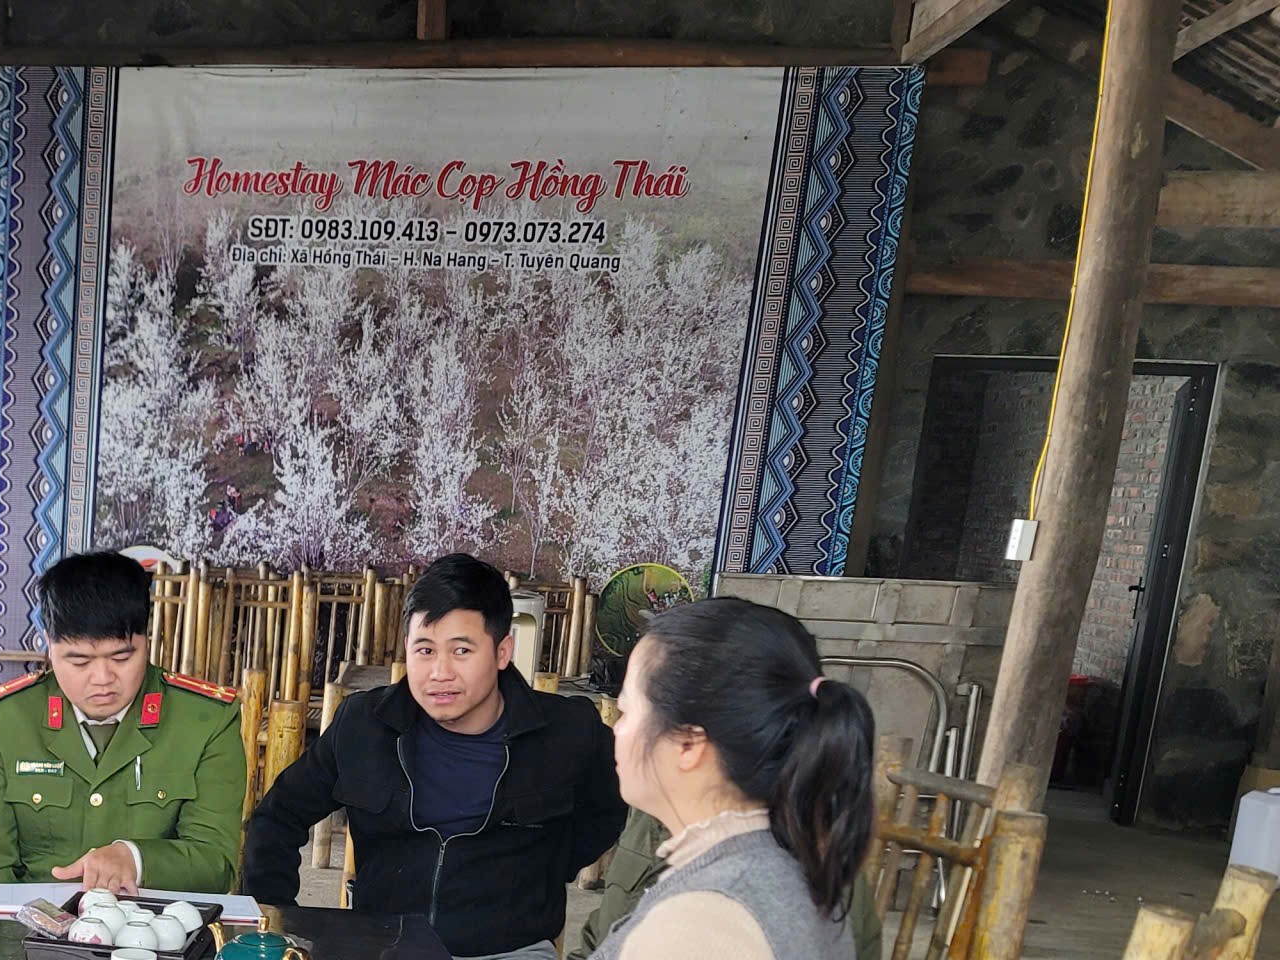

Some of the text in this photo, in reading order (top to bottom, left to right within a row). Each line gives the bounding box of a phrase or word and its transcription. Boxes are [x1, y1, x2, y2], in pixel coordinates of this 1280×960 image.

[184, 156, 689, 213] Homestay Mác Cọp Hồng Thái
[249, 218, 294, 239] SĐT:
[301, 219, 439, 241] 0983.109.413
[464, 221, 605, 243] 0973.073.274
[231, 246, 255, 265] Địa
[290, 249, 308, 264] Xã
[355, 250, 385, 266] Thái
[404, 253, 418, 266] H.
[423, 253, 442, 267] Na
[447, 253, 486, 271] Hang
[504, 253, 515, 268] T.
[520, 254, 564, 272] Tuyên
[569, 254, 620, 273] Quang
